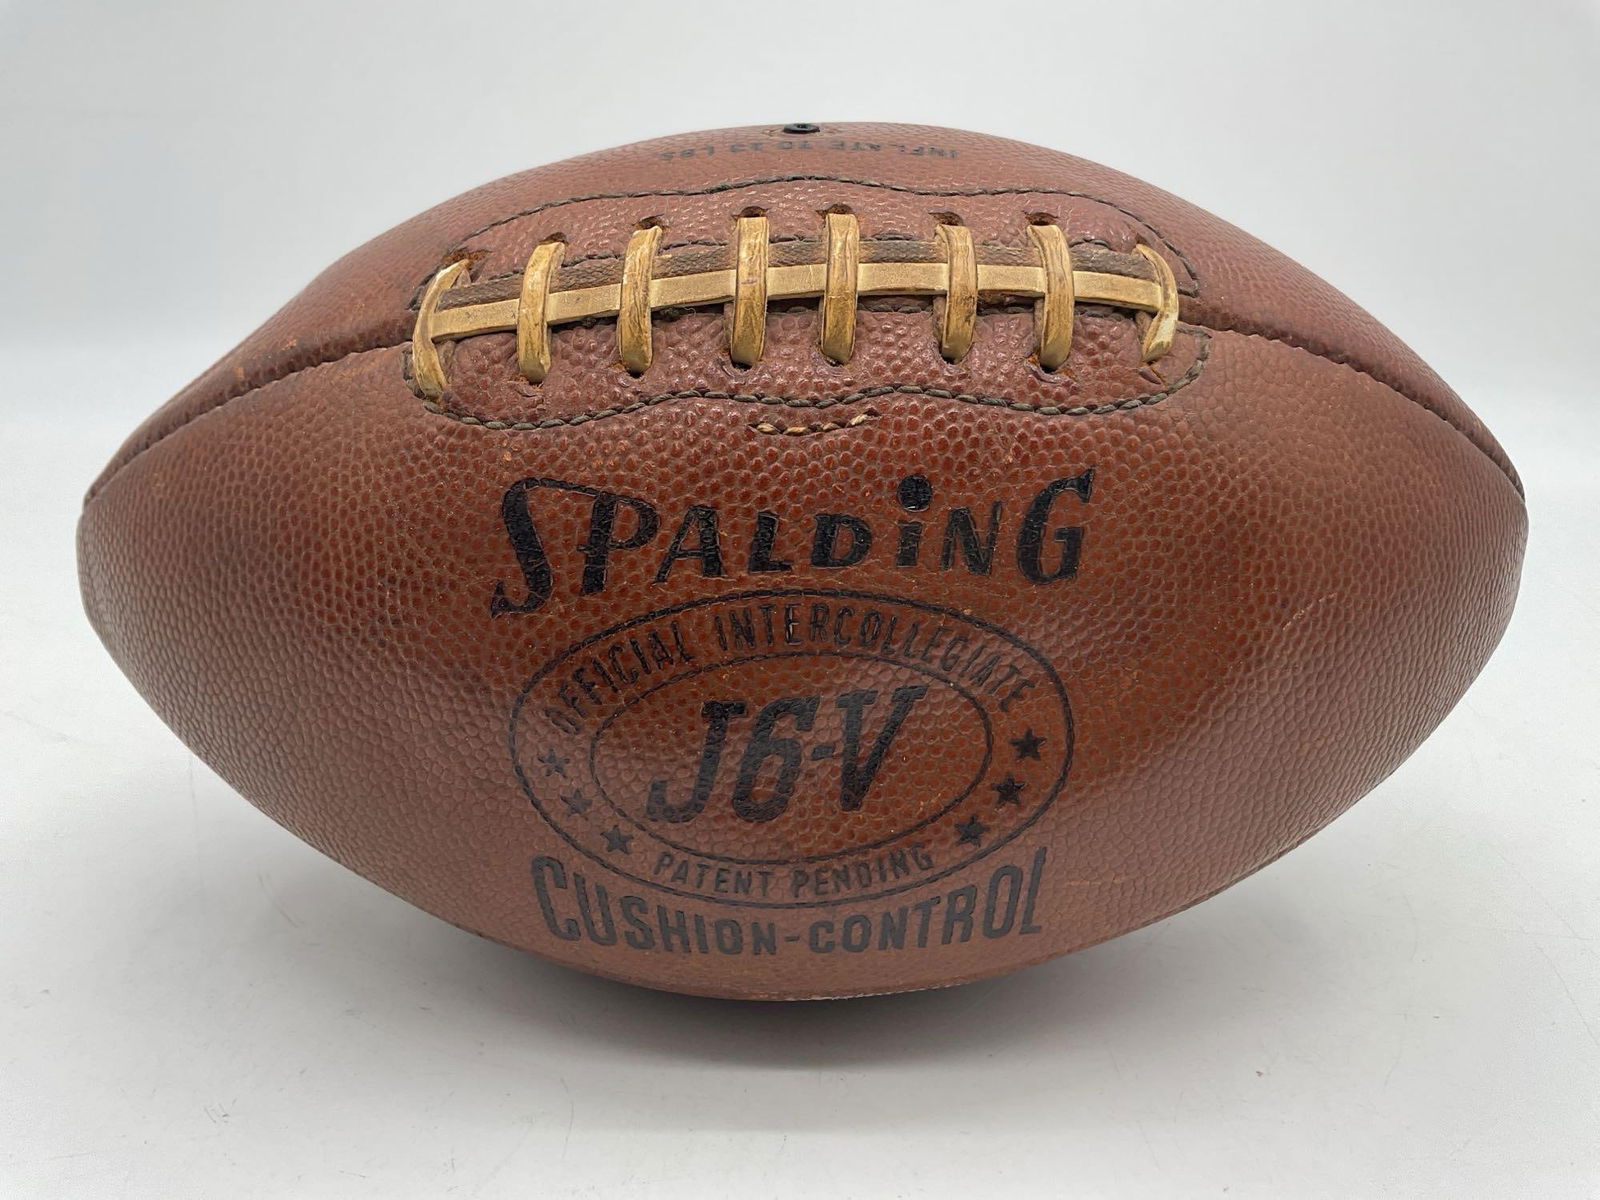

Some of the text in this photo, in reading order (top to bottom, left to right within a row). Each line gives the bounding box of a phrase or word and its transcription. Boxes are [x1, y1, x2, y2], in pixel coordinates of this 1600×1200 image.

[777, 140, 813, 152] TO
[830, 140, 959, 160] INFLATE
[545, 603, 1036, 735] OFFICIAL INTERCOLLEGIATE
[646, 685, 929, 823] J6-V
[531, 846, 1047, 955] CUSHION-CONTROL
[653, 842, 934, 898] PATENT PENDING
